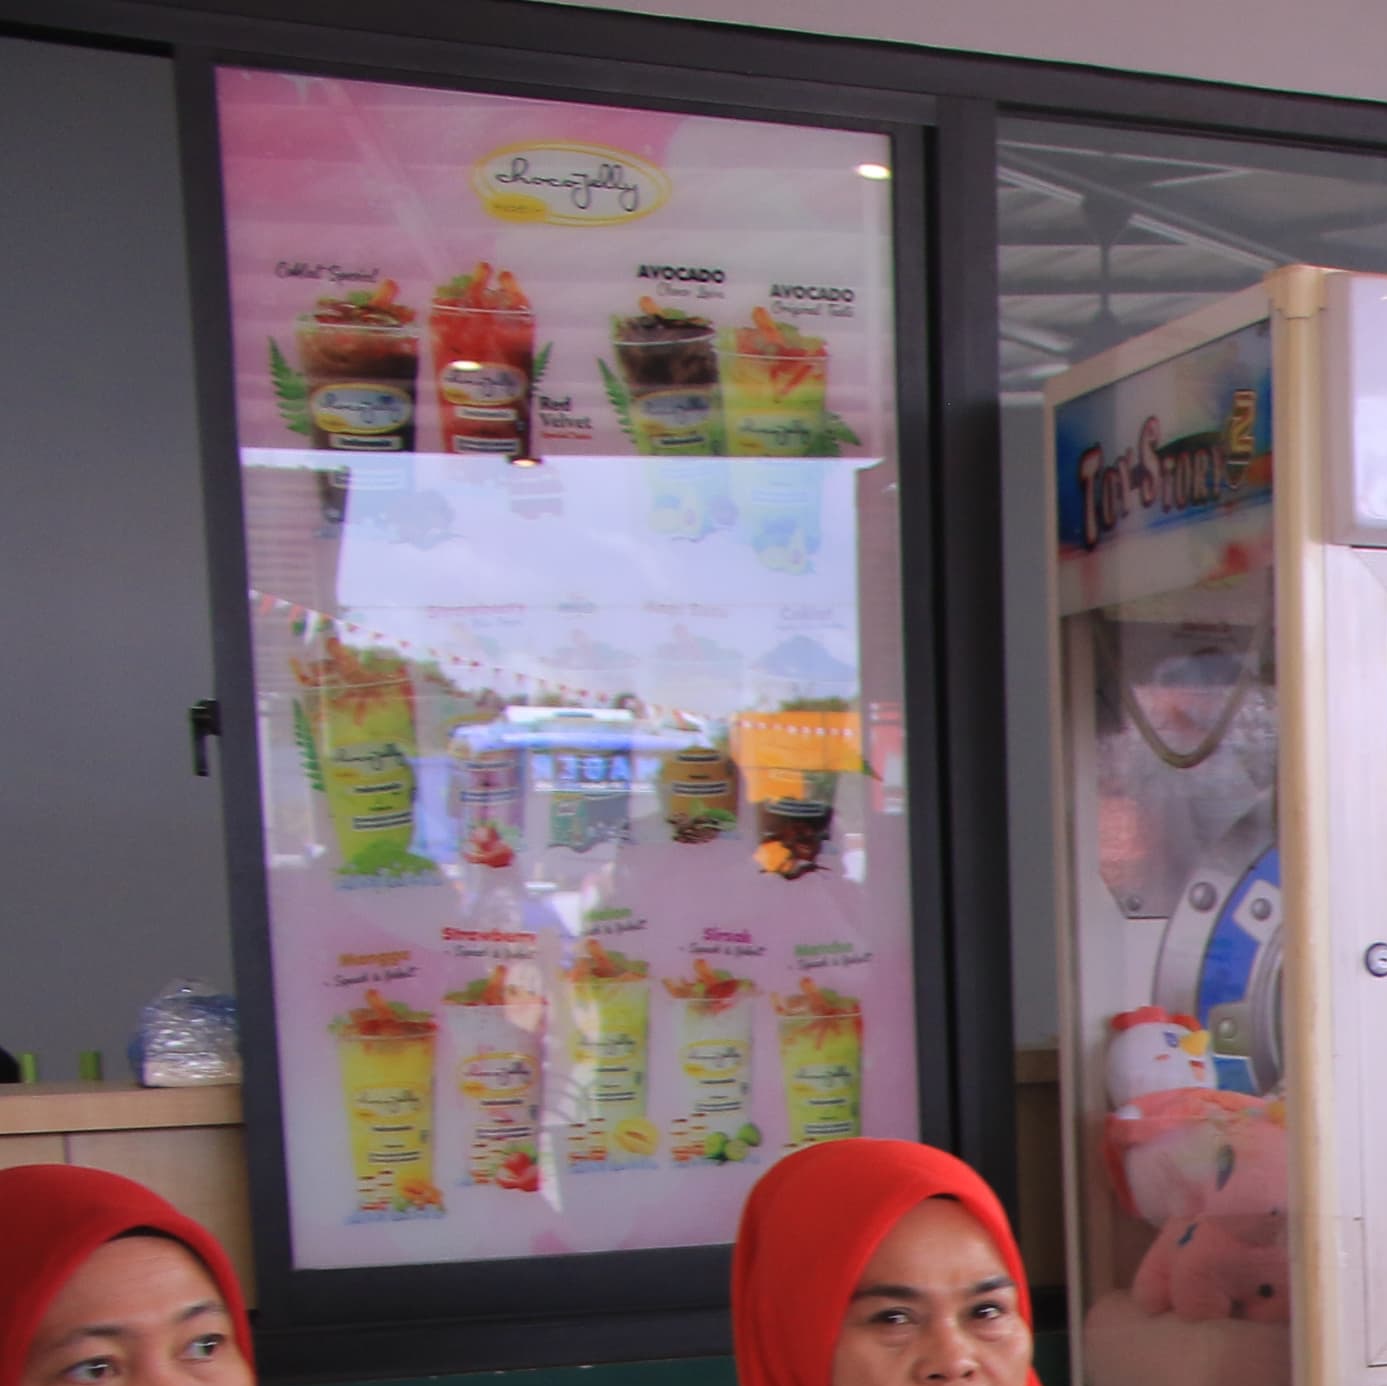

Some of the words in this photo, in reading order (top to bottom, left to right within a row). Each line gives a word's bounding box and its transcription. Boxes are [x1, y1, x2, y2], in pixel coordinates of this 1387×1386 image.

[637, 264, 726, 284] AVOCADO
[769, 284, 855, 302] AVOCADO
[540, 396, 571, 411] Red
[540, 411, 593, 430] Velvet
